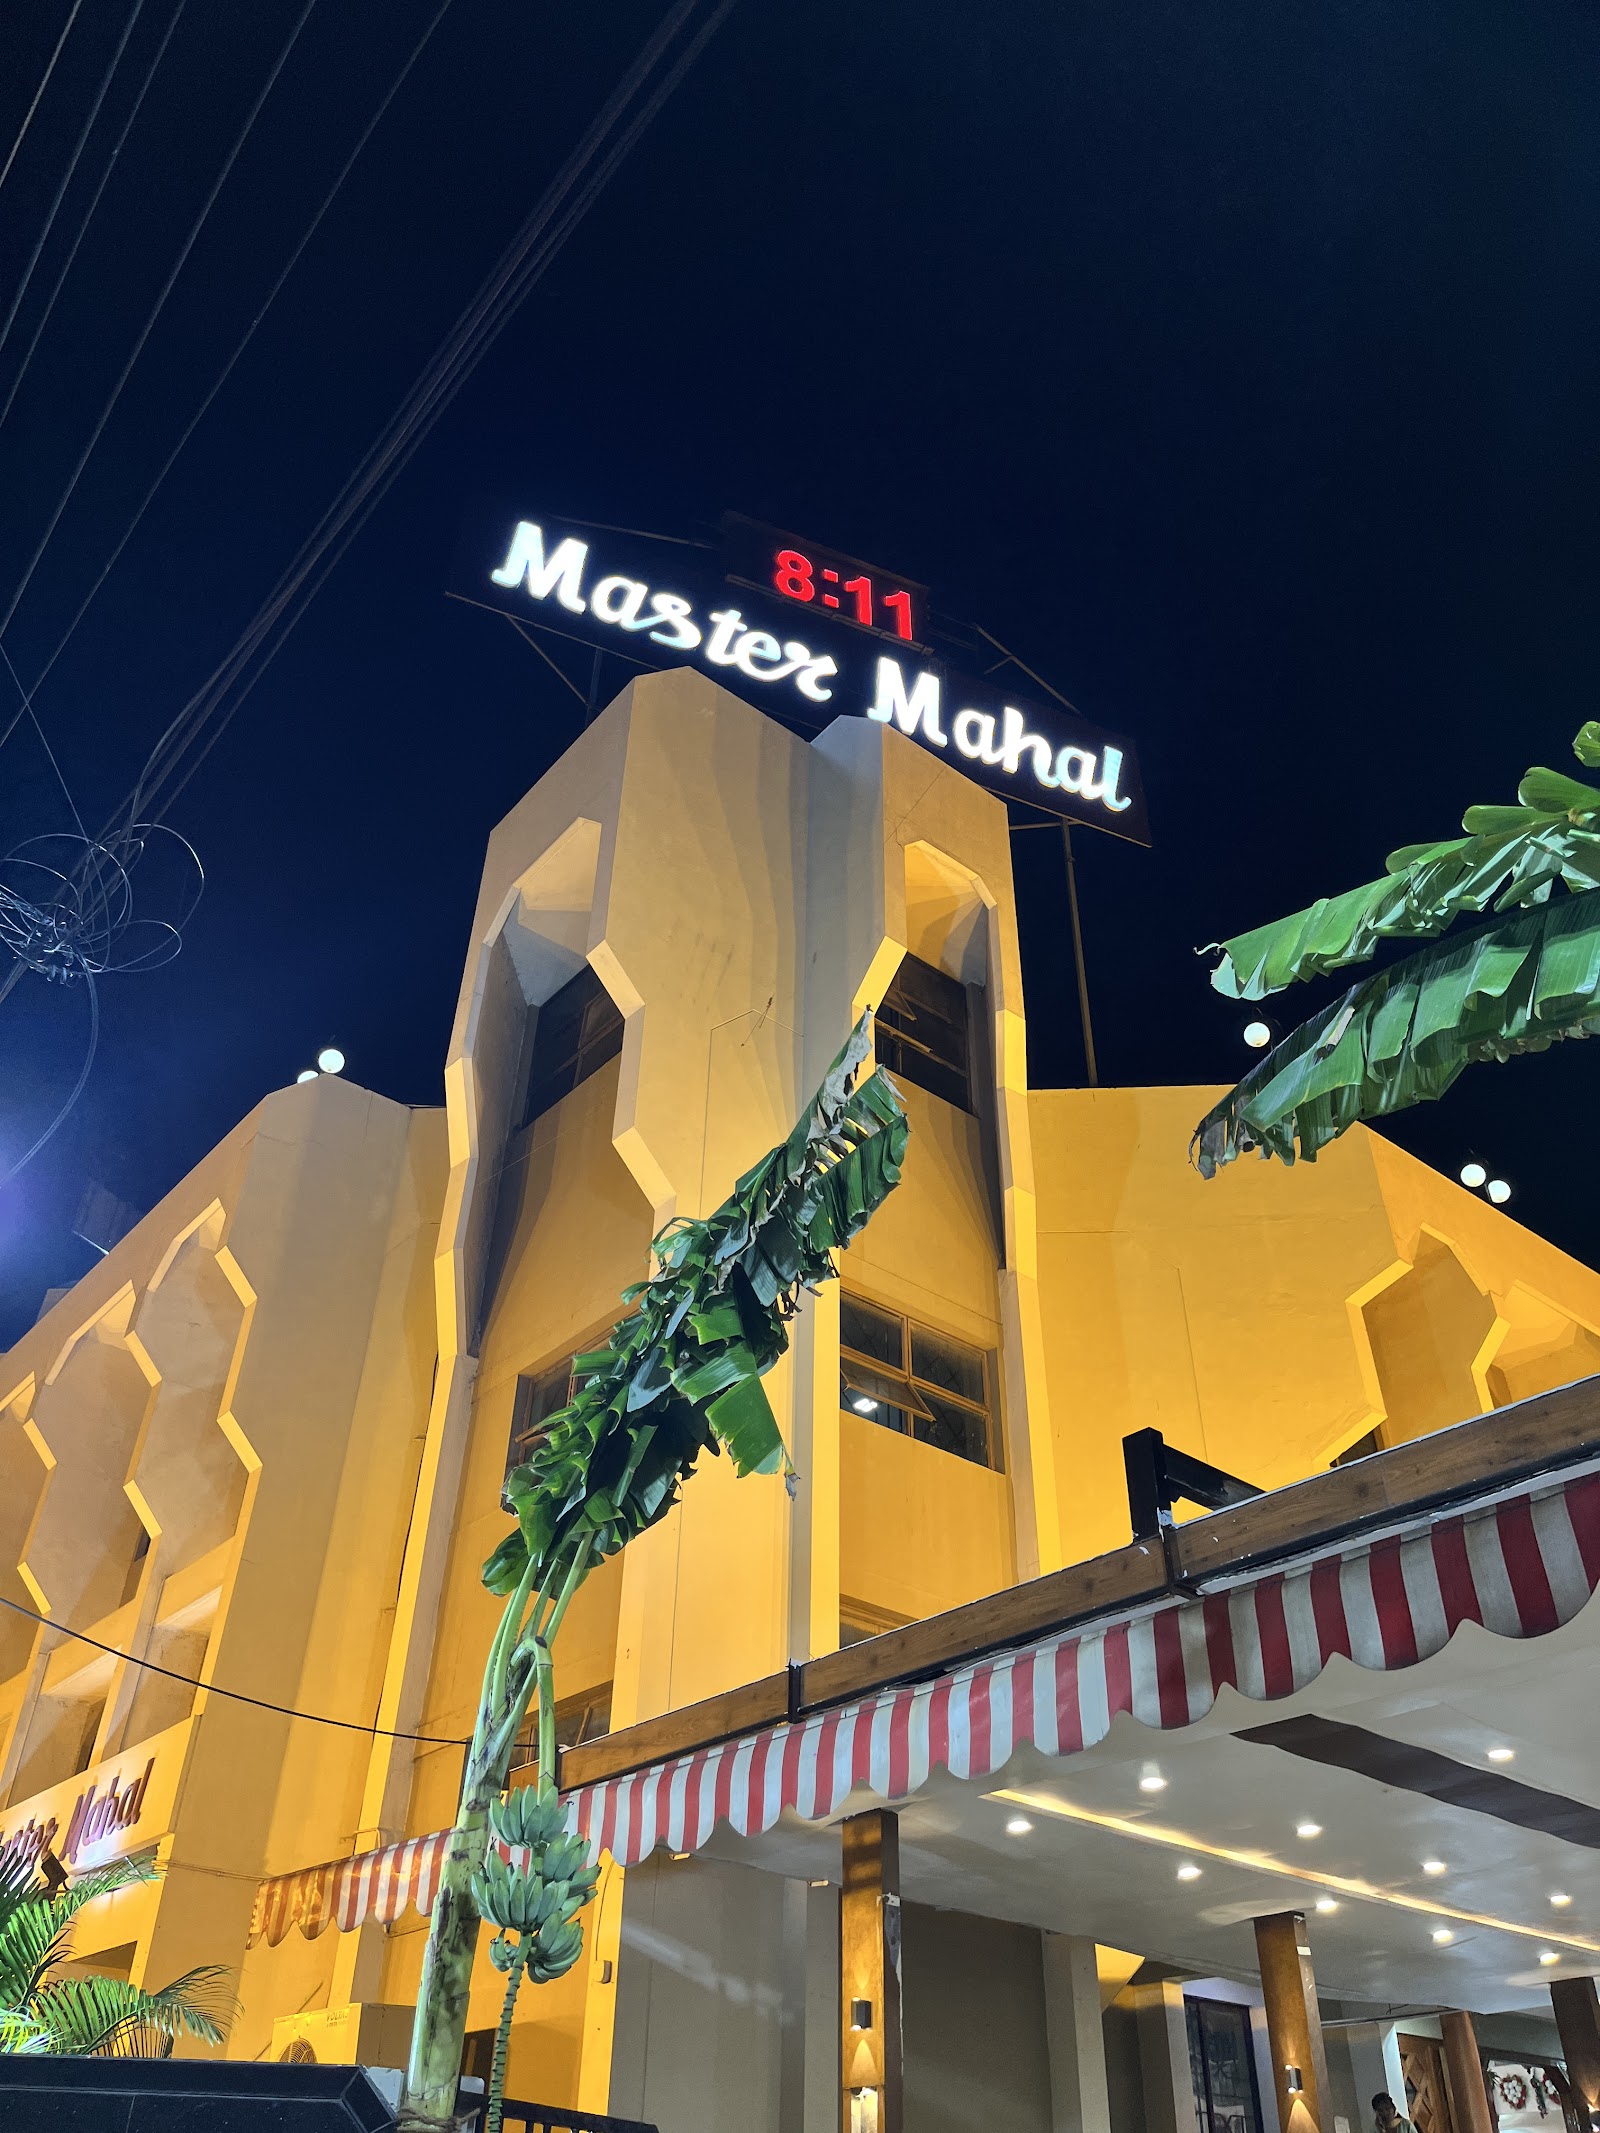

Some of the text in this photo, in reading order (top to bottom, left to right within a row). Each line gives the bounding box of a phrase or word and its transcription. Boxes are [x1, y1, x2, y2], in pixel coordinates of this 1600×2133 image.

[775, 550, 912, 641] 8:11
[491, 520, 1132, 812] Master Mahal
[58, 1757, 155, 1864] Mahal
